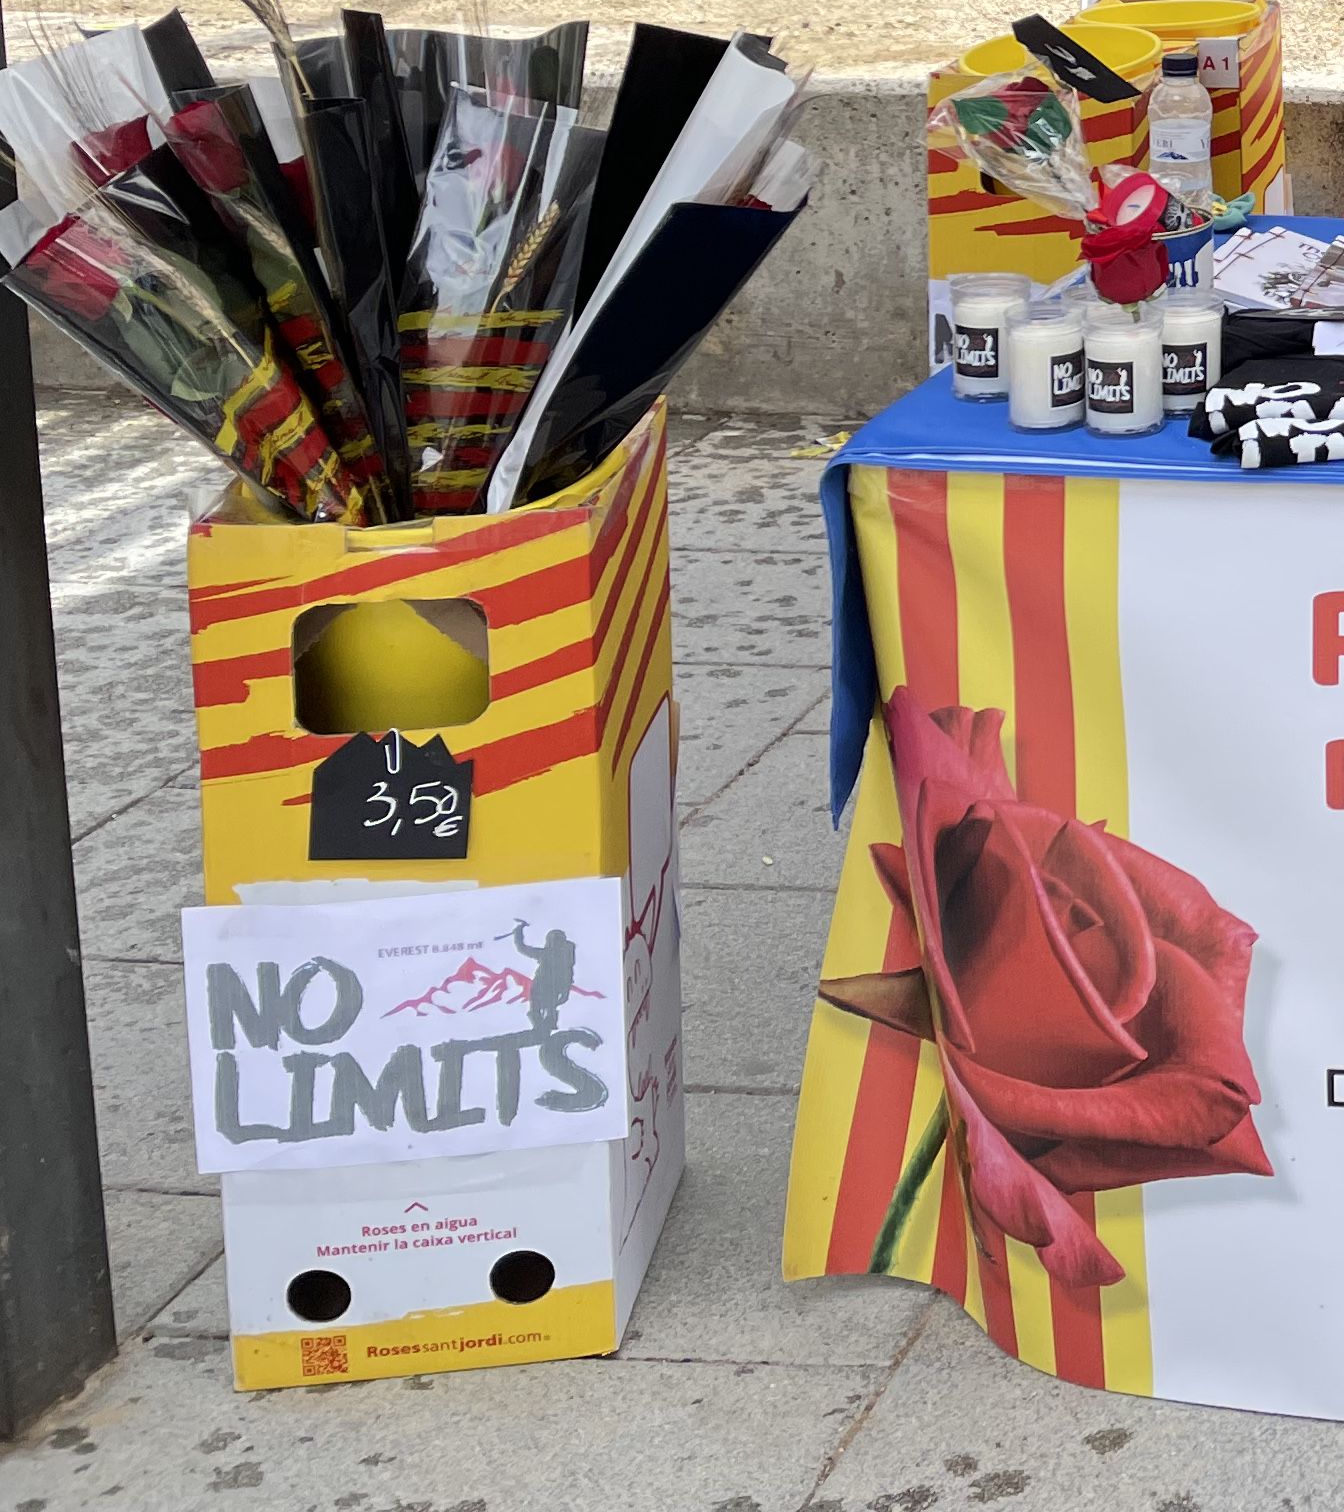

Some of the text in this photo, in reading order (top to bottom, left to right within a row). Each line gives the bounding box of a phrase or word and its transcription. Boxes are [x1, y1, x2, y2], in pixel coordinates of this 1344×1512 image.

[1203, 56, 1230, 71] A 1
[955, 349, 996, 366] LIMITS
[1053, 361, 1073, 380] NO
[1163, 365, 1205, 385] LIMITS
[1088, 383, 1131, 403] LIMITS
[377, 943, 431, 959] EVEREST
[206, 955, 364, 1052] NO
[215, 1027, 610, 1145] LIMITS
[361, 1214, 479, 1237] Roses en aigua
[316, 1226, 518, 1258] Mantenir la caixa vertical
[366, 1329, 545, 1359] Rosessantjordi.com
